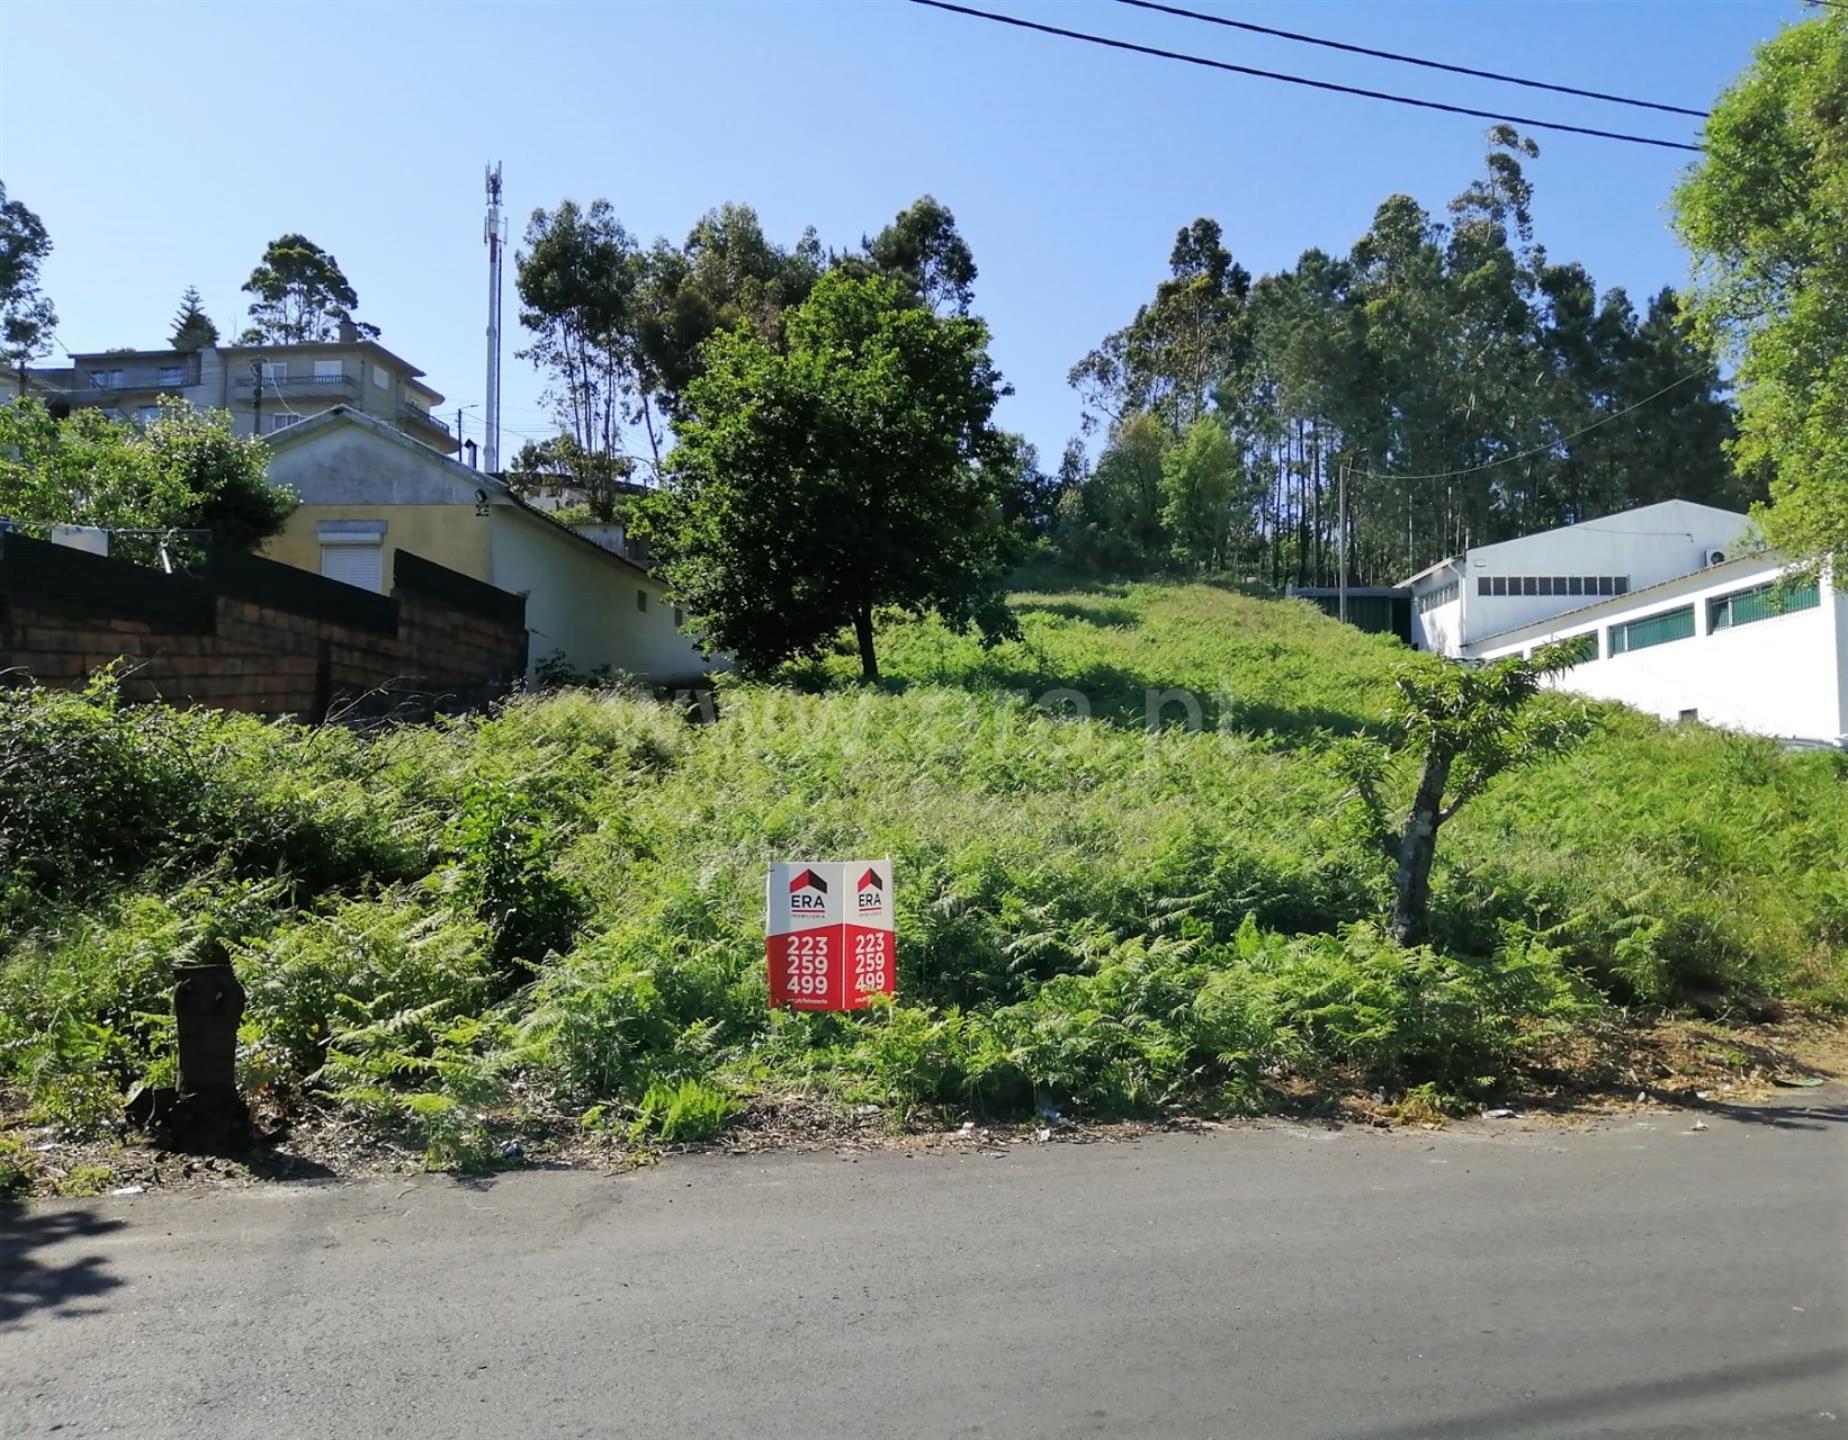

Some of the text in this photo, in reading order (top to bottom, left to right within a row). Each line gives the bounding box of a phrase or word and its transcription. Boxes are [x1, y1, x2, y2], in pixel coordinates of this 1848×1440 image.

[791, 895, 825, 908] ERA
[858, 893, 881, 907] ERA
[786, 935, 828, 955] 223
[855, 932, 885, 954] 223
[786, 955, 828, 975] 259
[855, 952, 885, 974] 259
[786, 975, 828, 995] 499
[855, 971, 885, 992] 499
